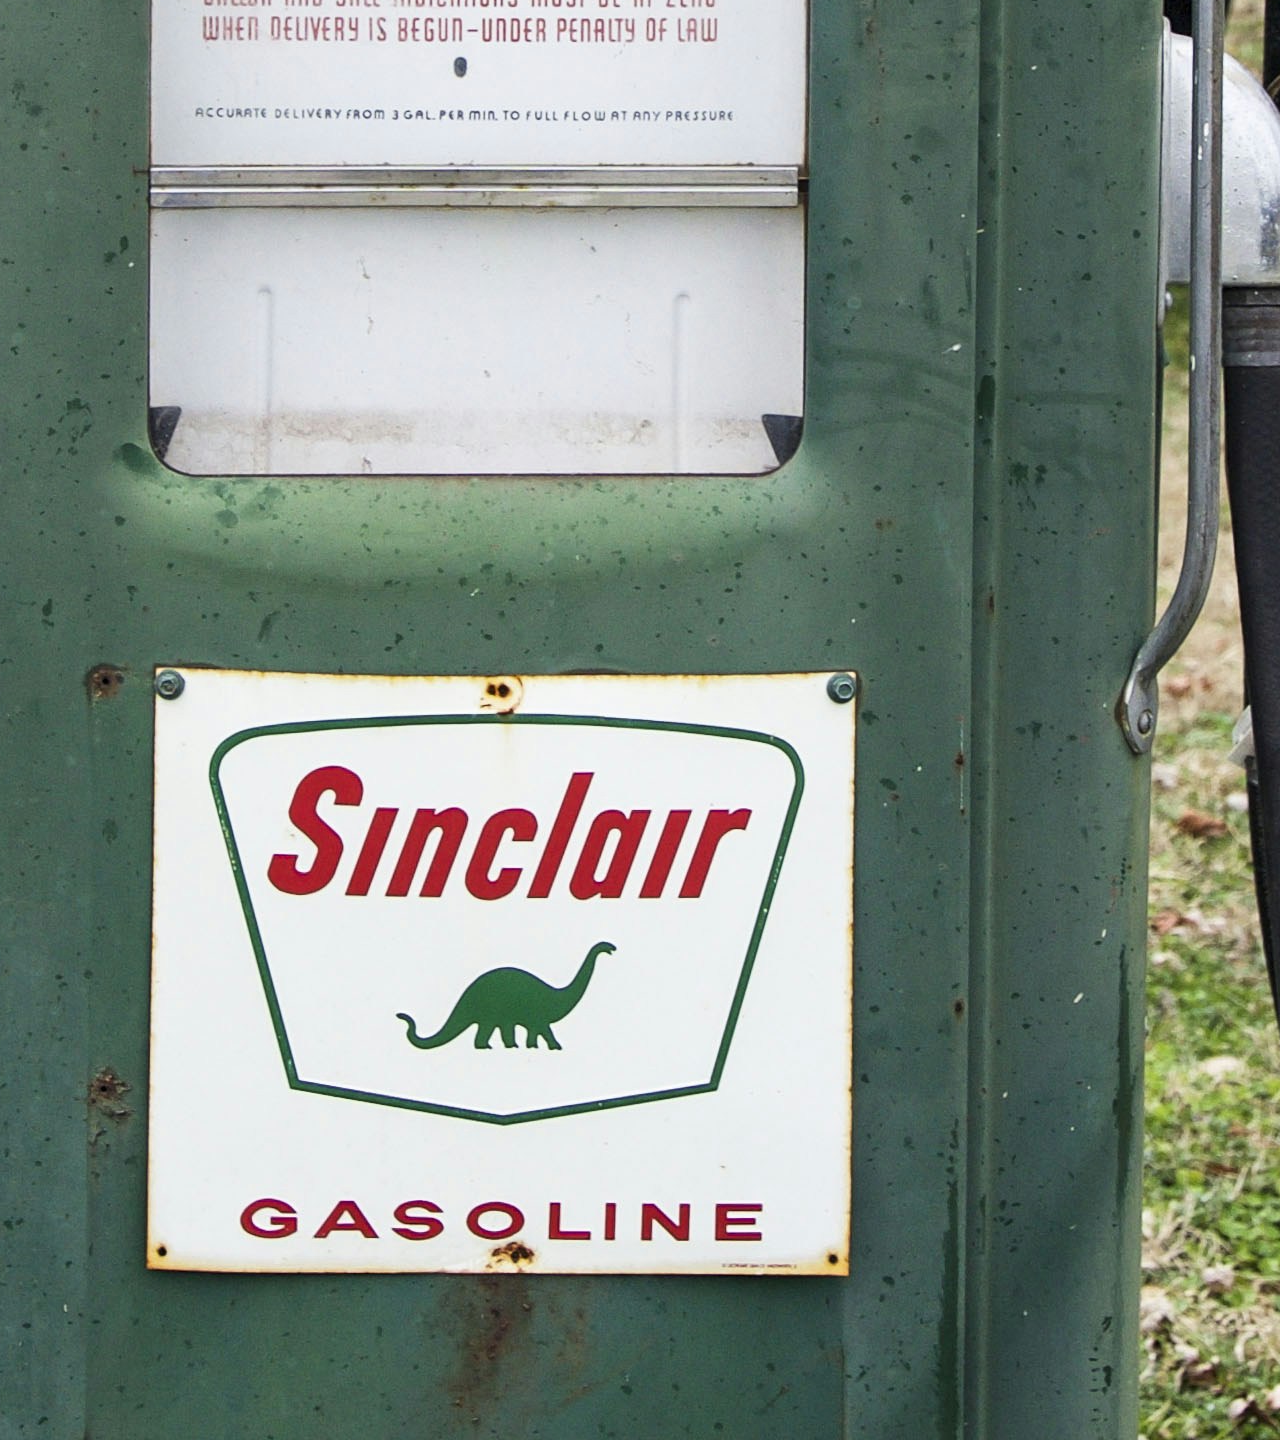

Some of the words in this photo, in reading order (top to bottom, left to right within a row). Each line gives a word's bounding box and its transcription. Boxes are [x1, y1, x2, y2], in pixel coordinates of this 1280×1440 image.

[202, 16, 259, 42] WHEN
[271, 17, 359, 42] DELIVERY
[369, 17, 387, 42] IS
[557, 18, 635, 43] PENALTY
[646, 18, 667, 42] OF
[678, 18, 718, 42] LAW
[195, 107, 267, 119] ACCURATE
[274, 108, 341, 120] DELIVERY
[346, 108, 385, 120] FROM
[392, 109, 399, 121] 3
[438, 109, 464, 121] PER
[503, 110, 520, 121] TO
[526, 110, 558, 122] FULL
[564, 110, 606, 122] FLOW
[610, 110, 627, 122] AT
[633, 110, 661, 122] ANY
[666, 110, 734, 122] PRESSURE
[266, 764, 752, 902] Sinclair
[239, 1197, 764, 1244] GASOLINE
